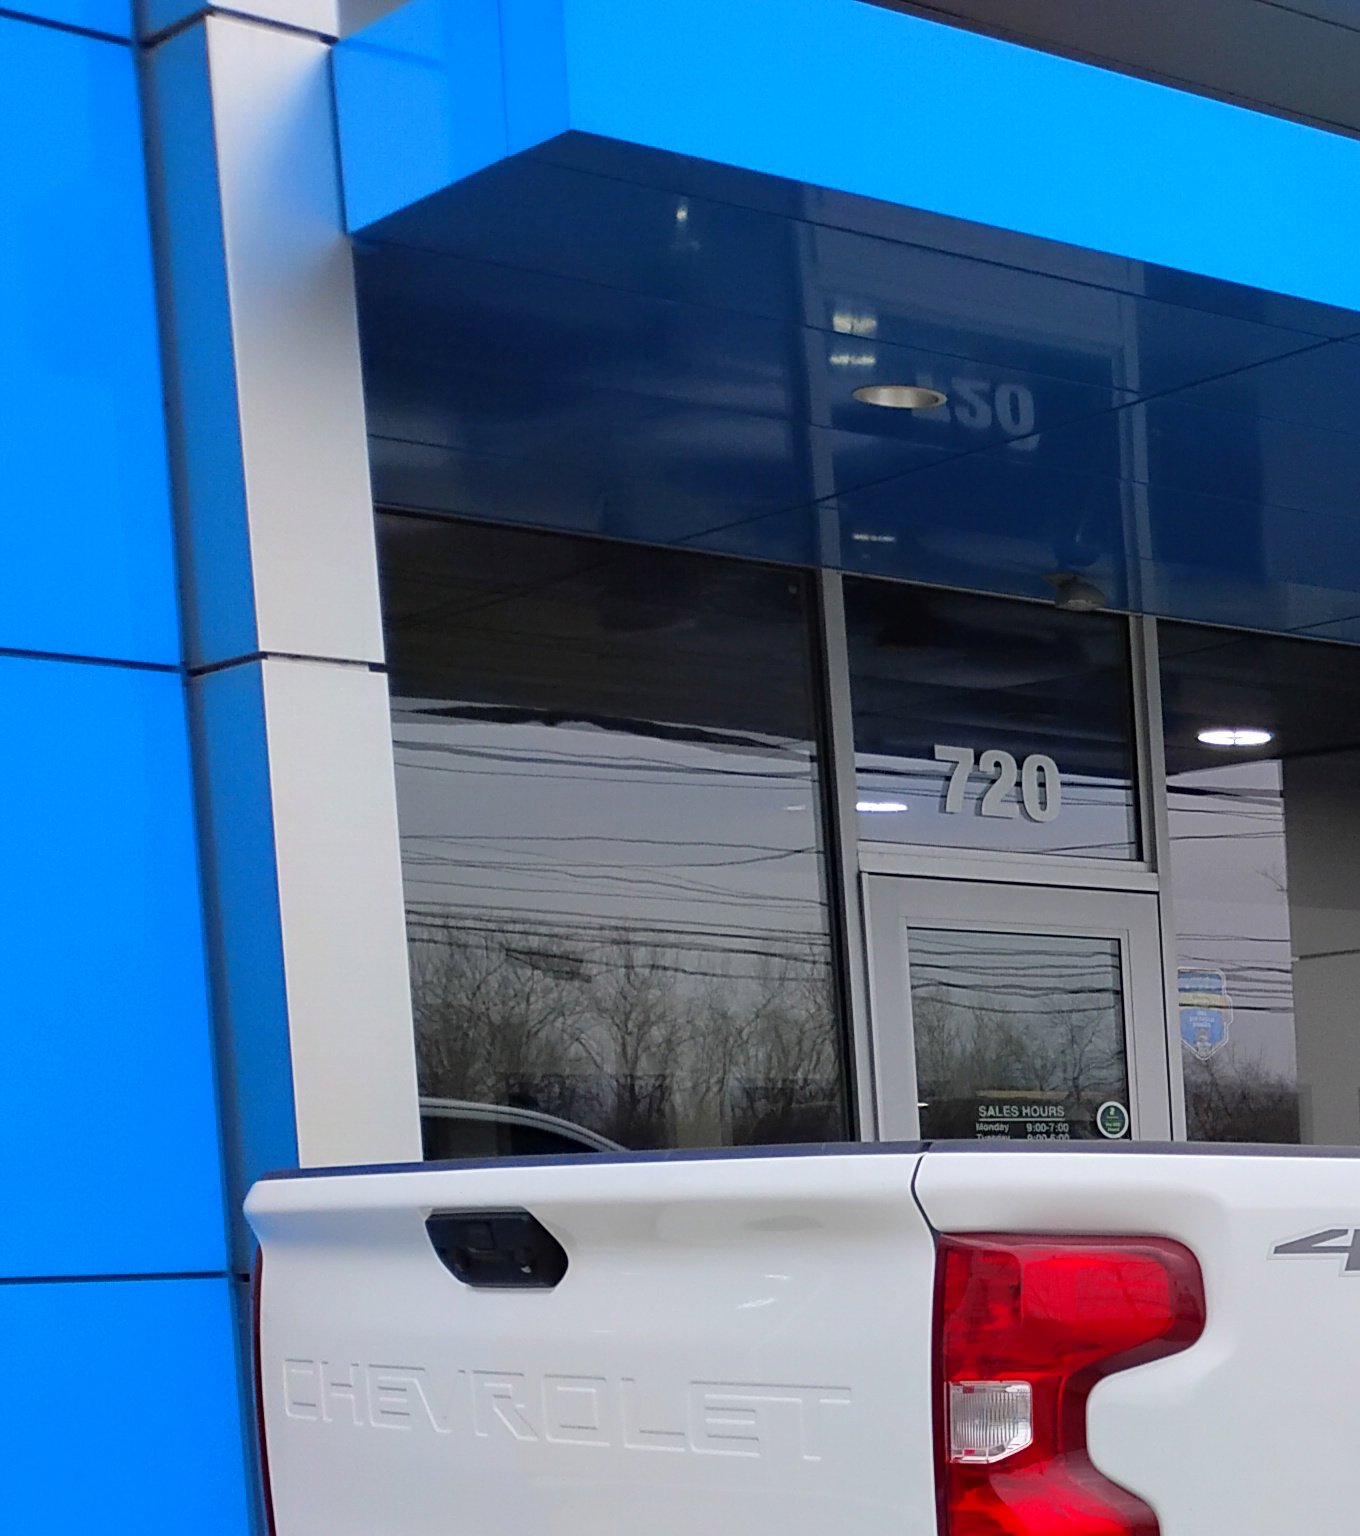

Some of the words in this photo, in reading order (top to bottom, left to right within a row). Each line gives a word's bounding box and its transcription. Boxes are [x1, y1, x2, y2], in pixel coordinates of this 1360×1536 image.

[934, 743, 1062, 823] 720
[976, 1123, 1010, 1133] Monday
[1026, 1123, 1069, 1133] 9:00-7:00
[978, 1105, 1019, 1117] SALES
[1022, 1105, 1065, 1117] HOURS
[282, 1356, 852, 1462] CHEVROLET
